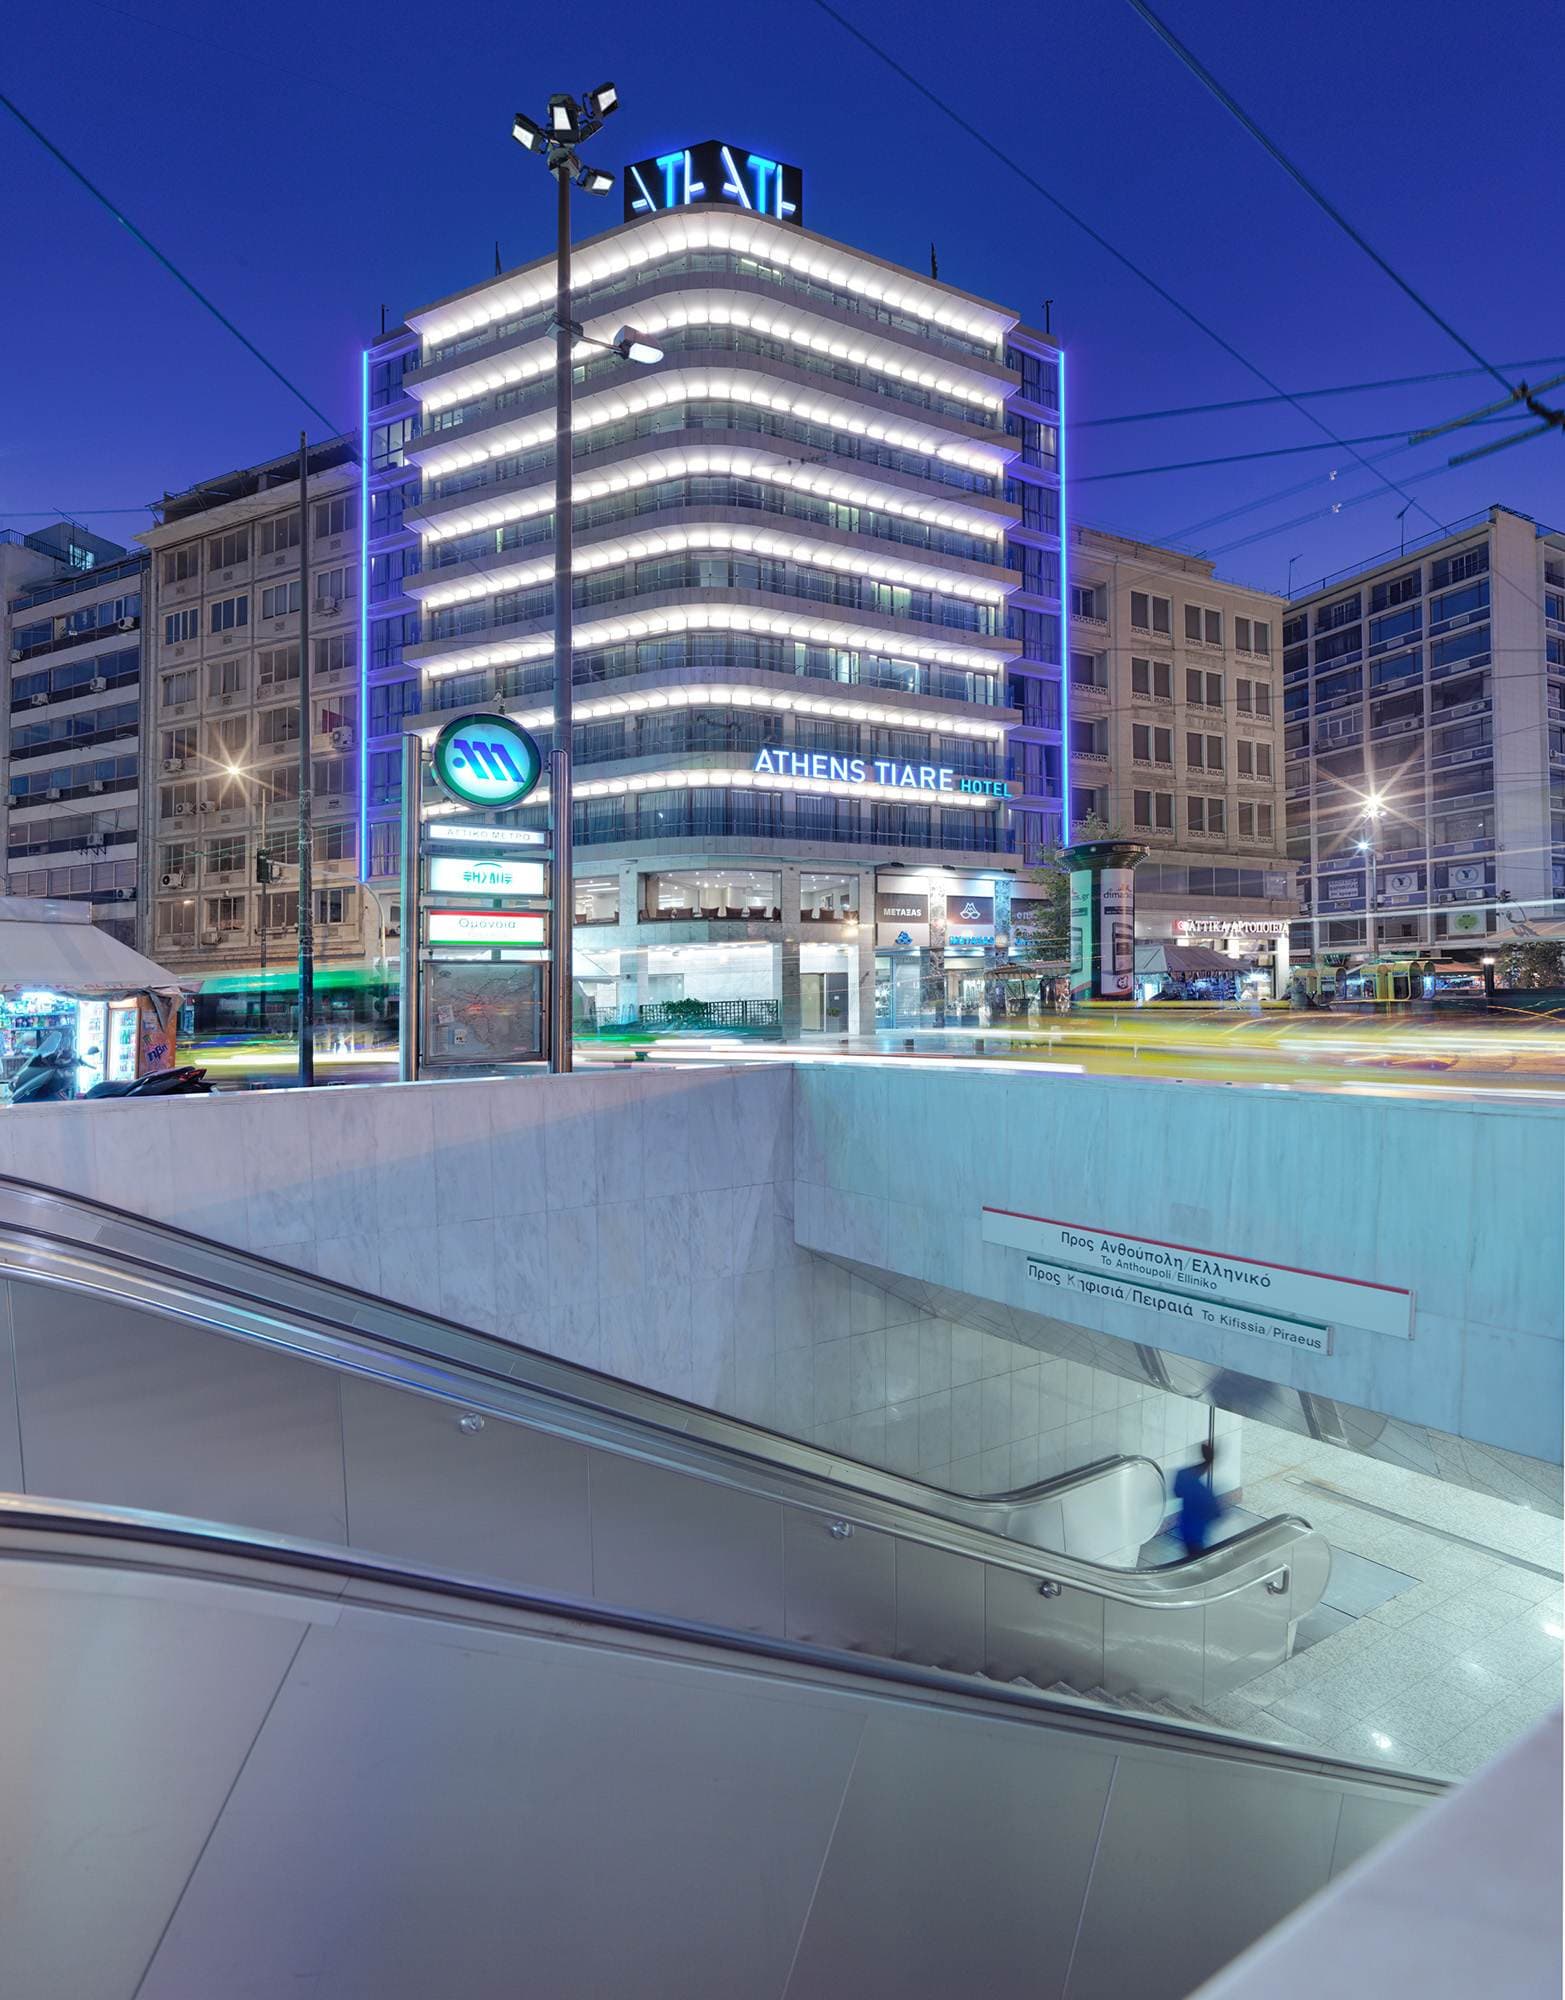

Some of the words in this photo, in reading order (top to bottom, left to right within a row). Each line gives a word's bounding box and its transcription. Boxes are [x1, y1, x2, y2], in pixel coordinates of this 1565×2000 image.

[754, 748, 866, 784] ATHENS
[874, 761, 954, 792] TIARE
[960, 778, 1013, 798] HOTEL
[1061, 1231, 1095, 1252] Προς
[1101, 1255, 1112, 1266] To
[1028, 1265, 1061, 1286] Προς
[1201, 1310, 1215, 1322] To
